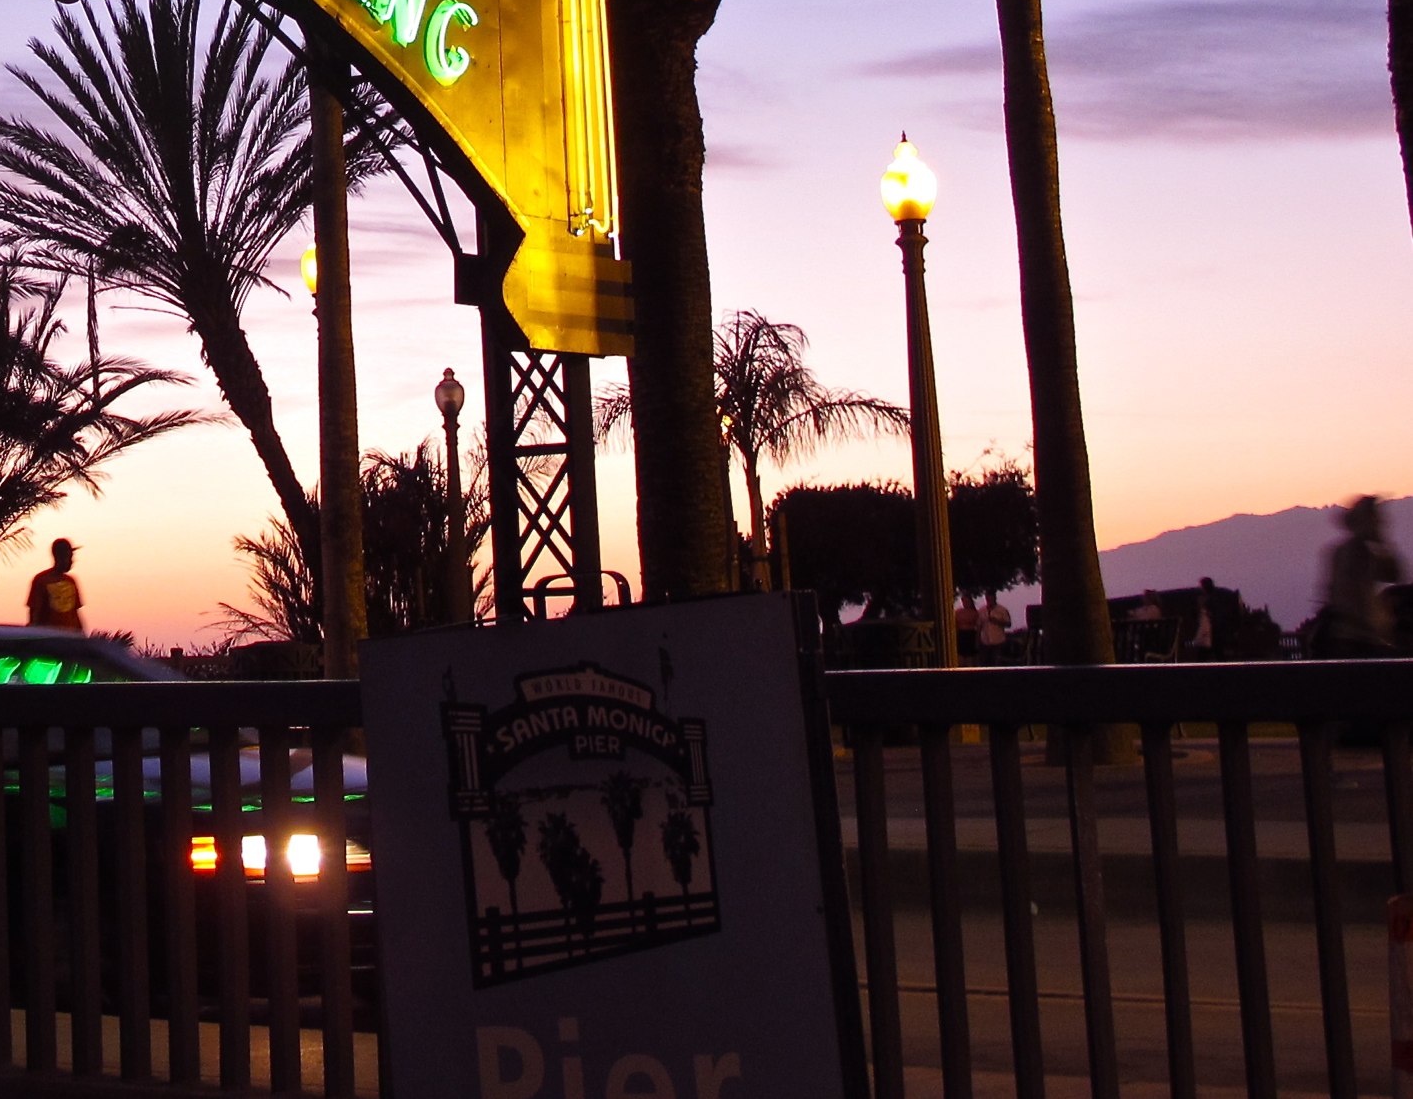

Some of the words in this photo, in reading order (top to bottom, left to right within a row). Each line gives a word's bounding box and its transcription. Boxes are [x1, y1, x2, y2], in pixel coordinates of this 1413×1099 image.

[532, 678, 581, 694] WORLD
[591, 678, 642, 703] FAMOUS
[497, 706, 578, 752] SANTA
[588, 706, 676, 745] MONICA
[575, 734, 620, 754] PIER
